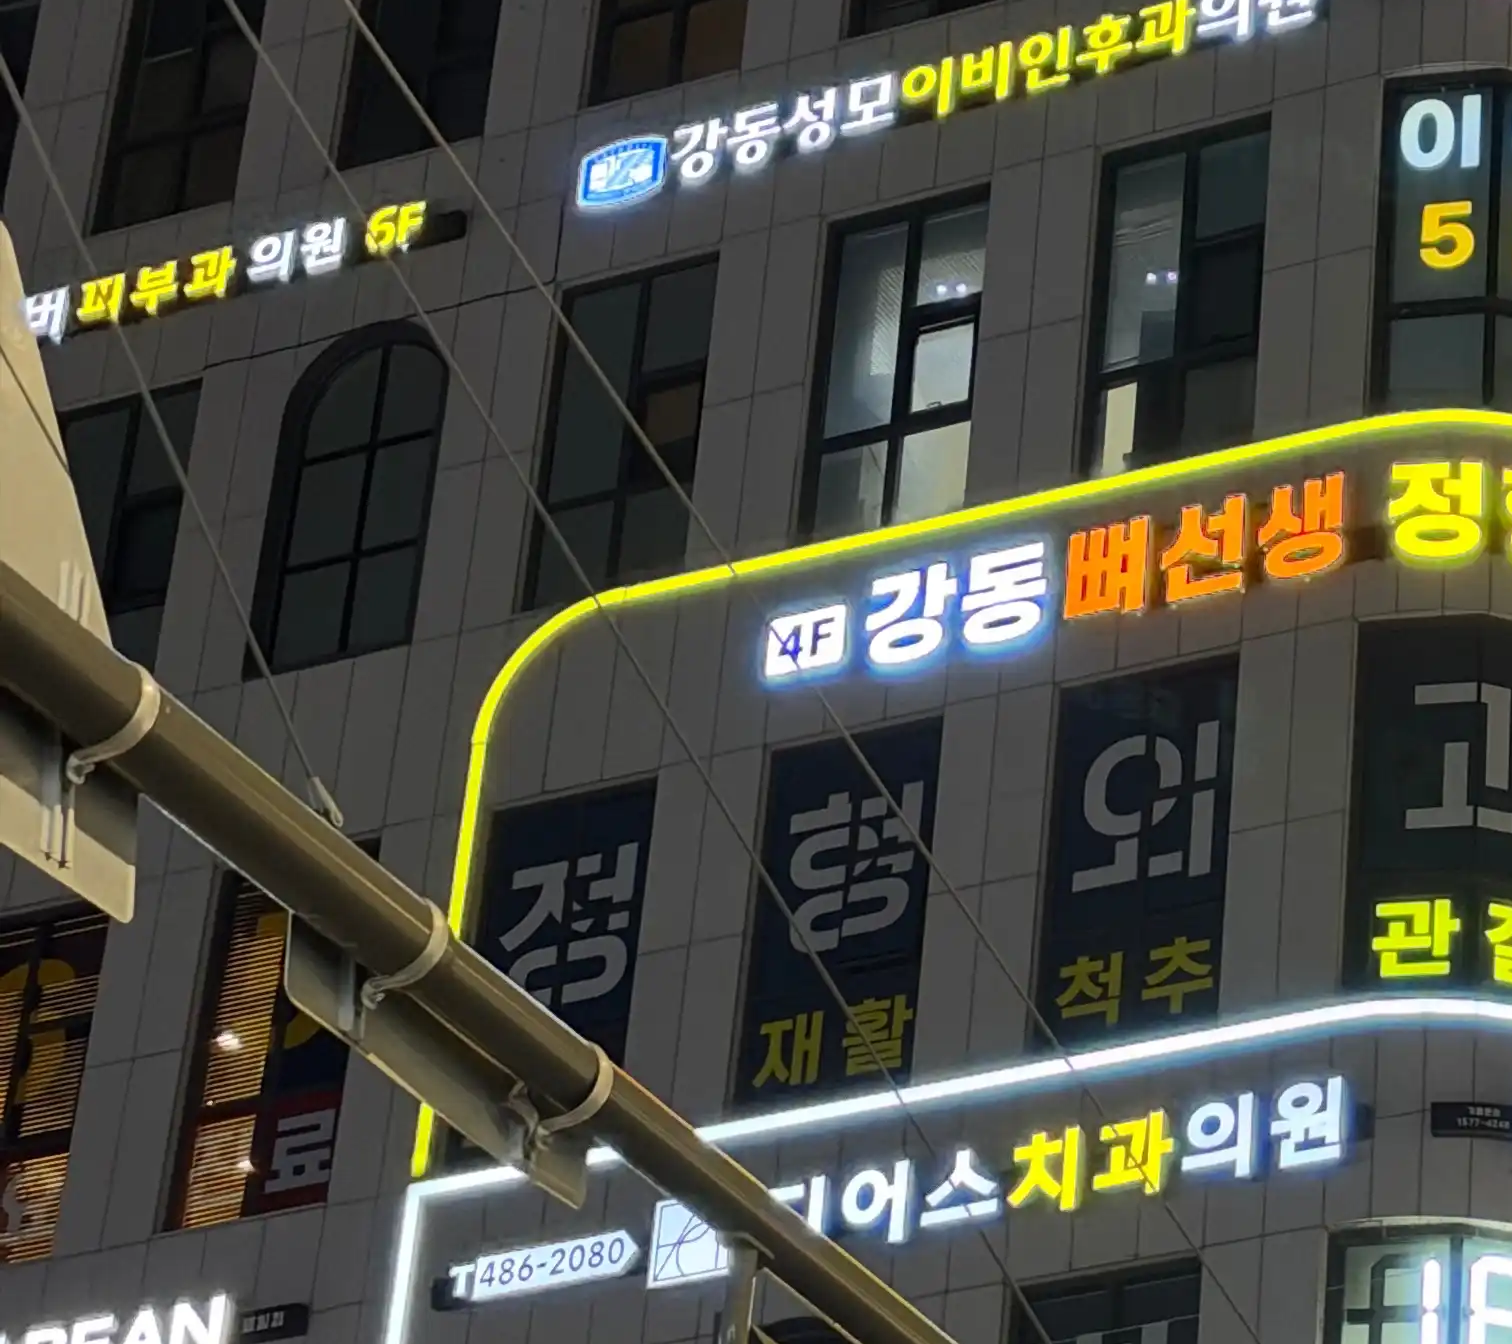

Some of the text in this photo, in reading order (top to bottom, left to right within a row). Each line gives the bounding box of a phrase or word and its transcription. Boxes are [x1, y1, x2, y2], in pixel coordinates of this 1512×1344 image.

[752, 994, 915, 1089] 재활
[1054, 936, 1216, 1029] 척추
[479, 1236, 626, 1288] 486-2080
